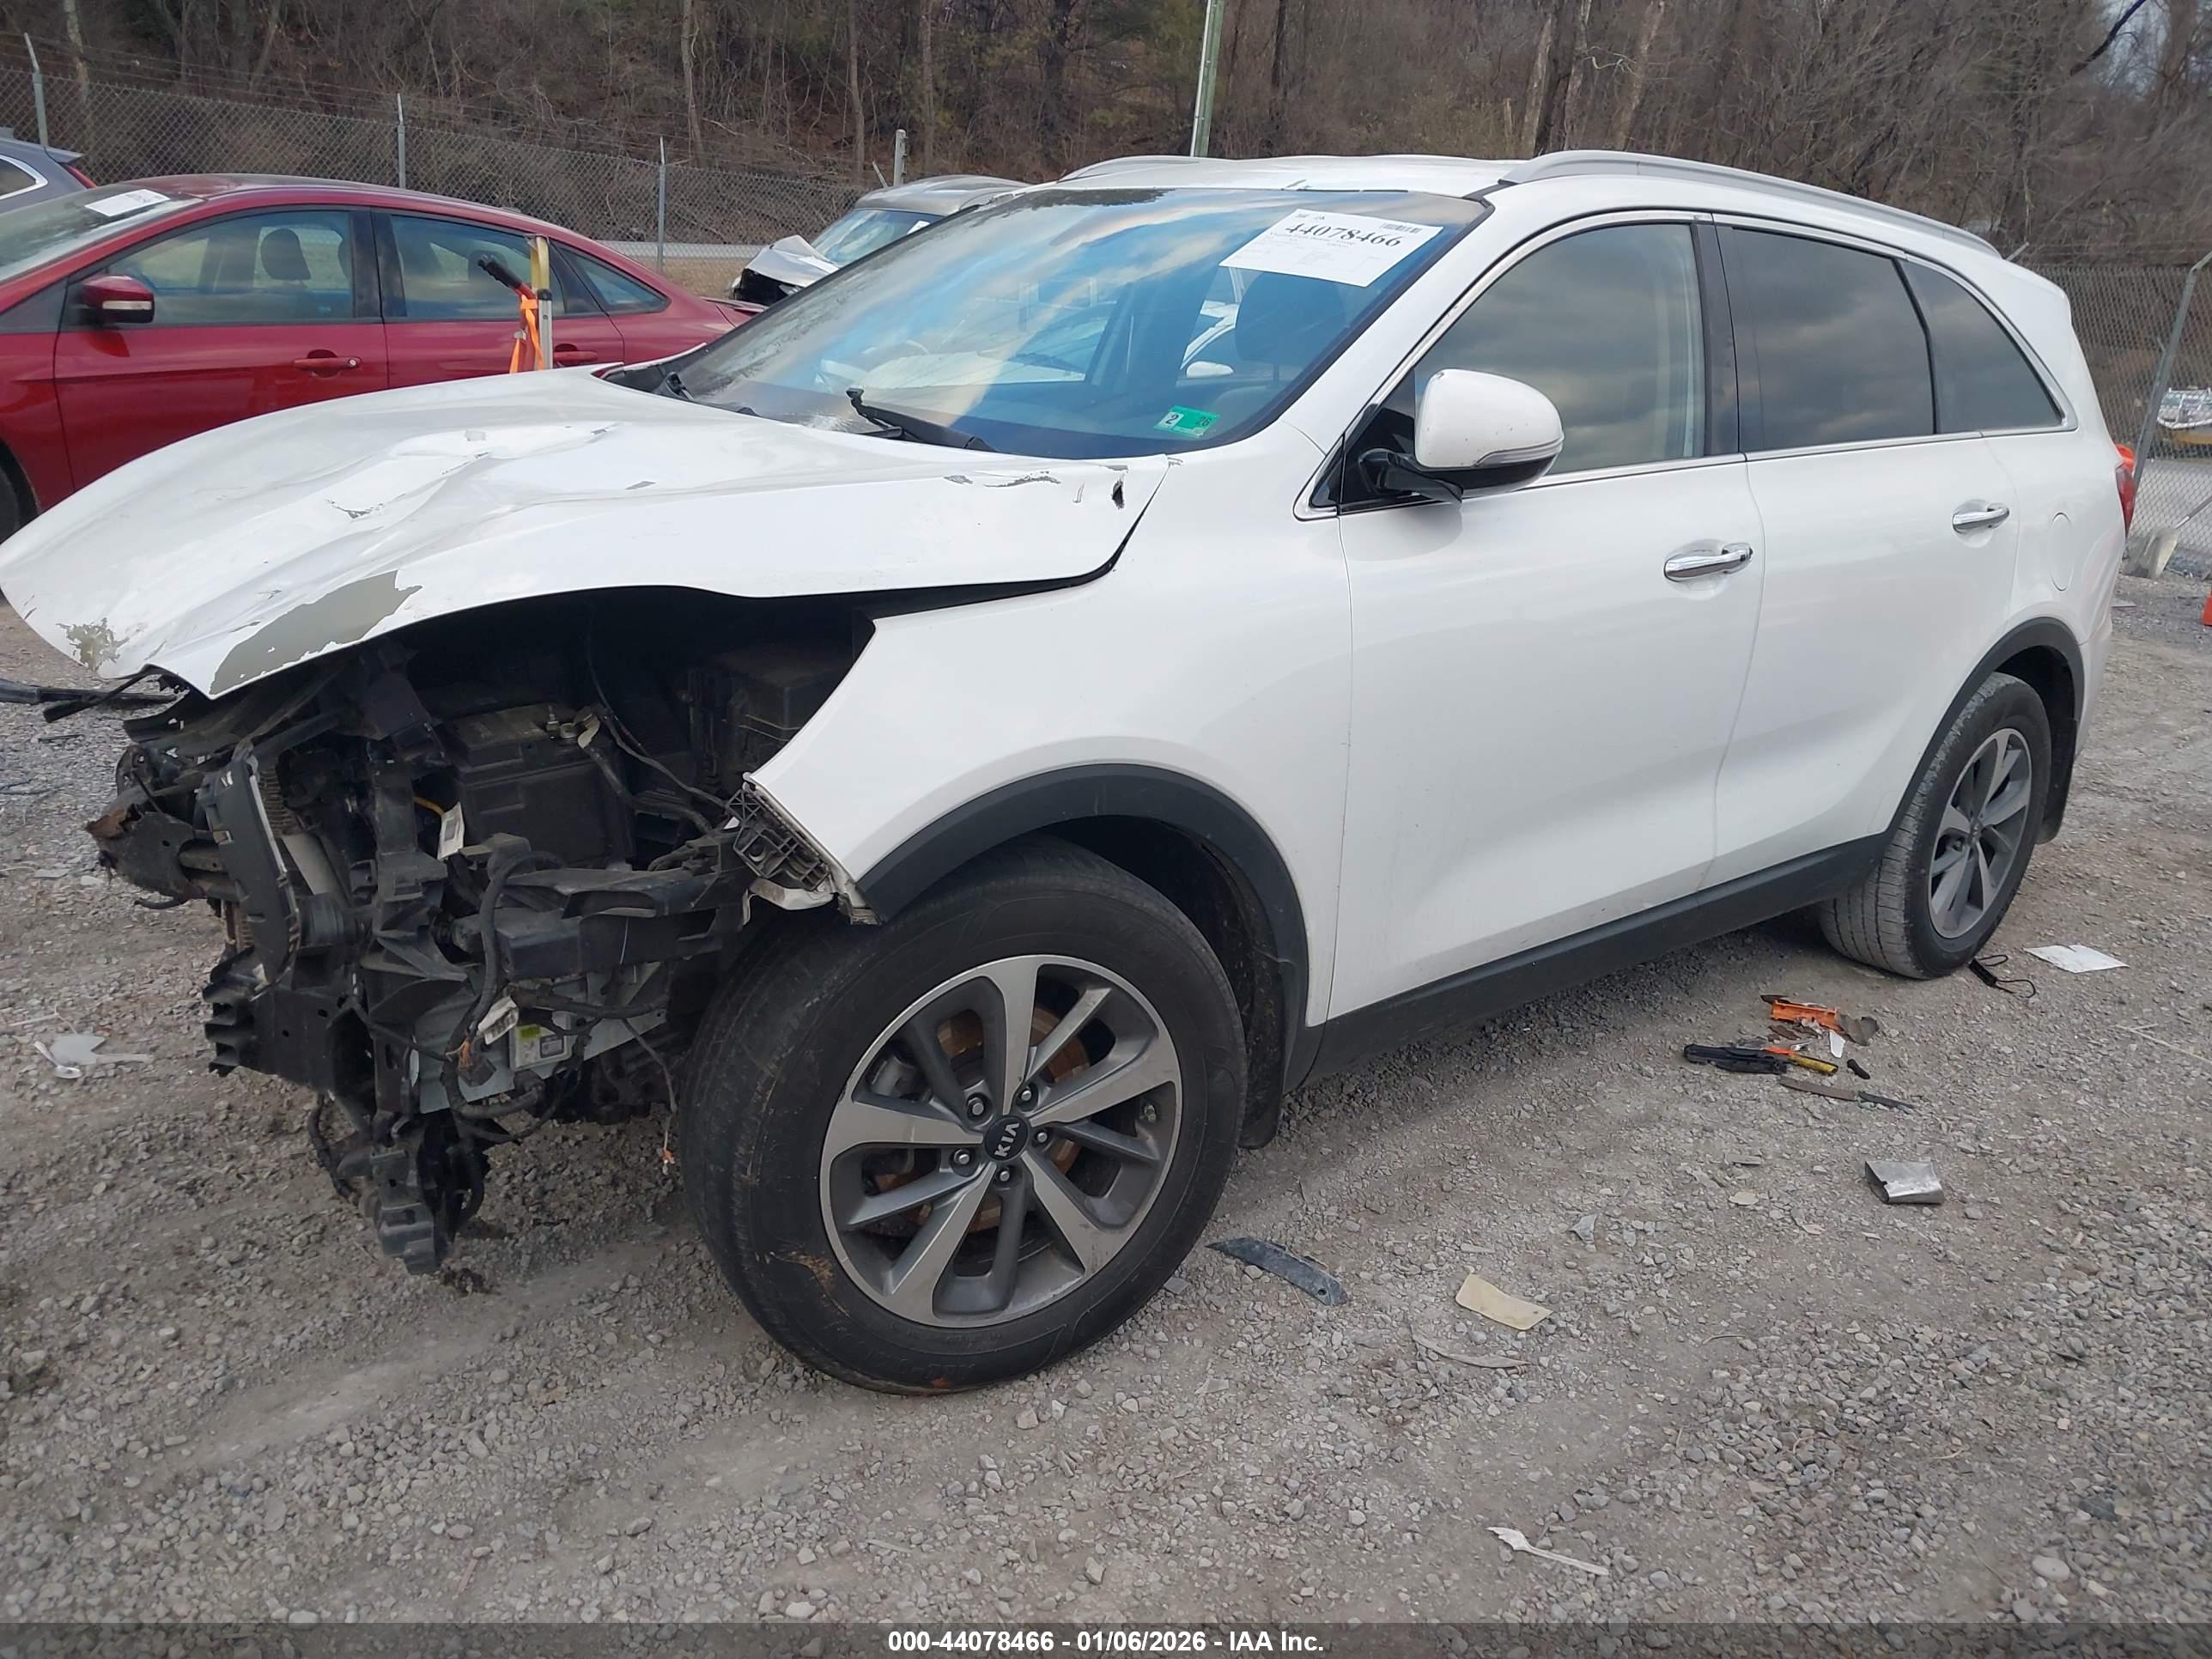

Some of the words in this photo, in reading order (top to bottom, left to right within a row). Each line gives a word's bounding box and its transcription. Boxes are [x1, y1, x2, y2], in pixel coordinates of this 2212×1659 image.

[1285, 222, 1402, 248] 44078466
[1165, 414, 1179, 425] 2
[994, 1122, 1020, 1158] KIA
